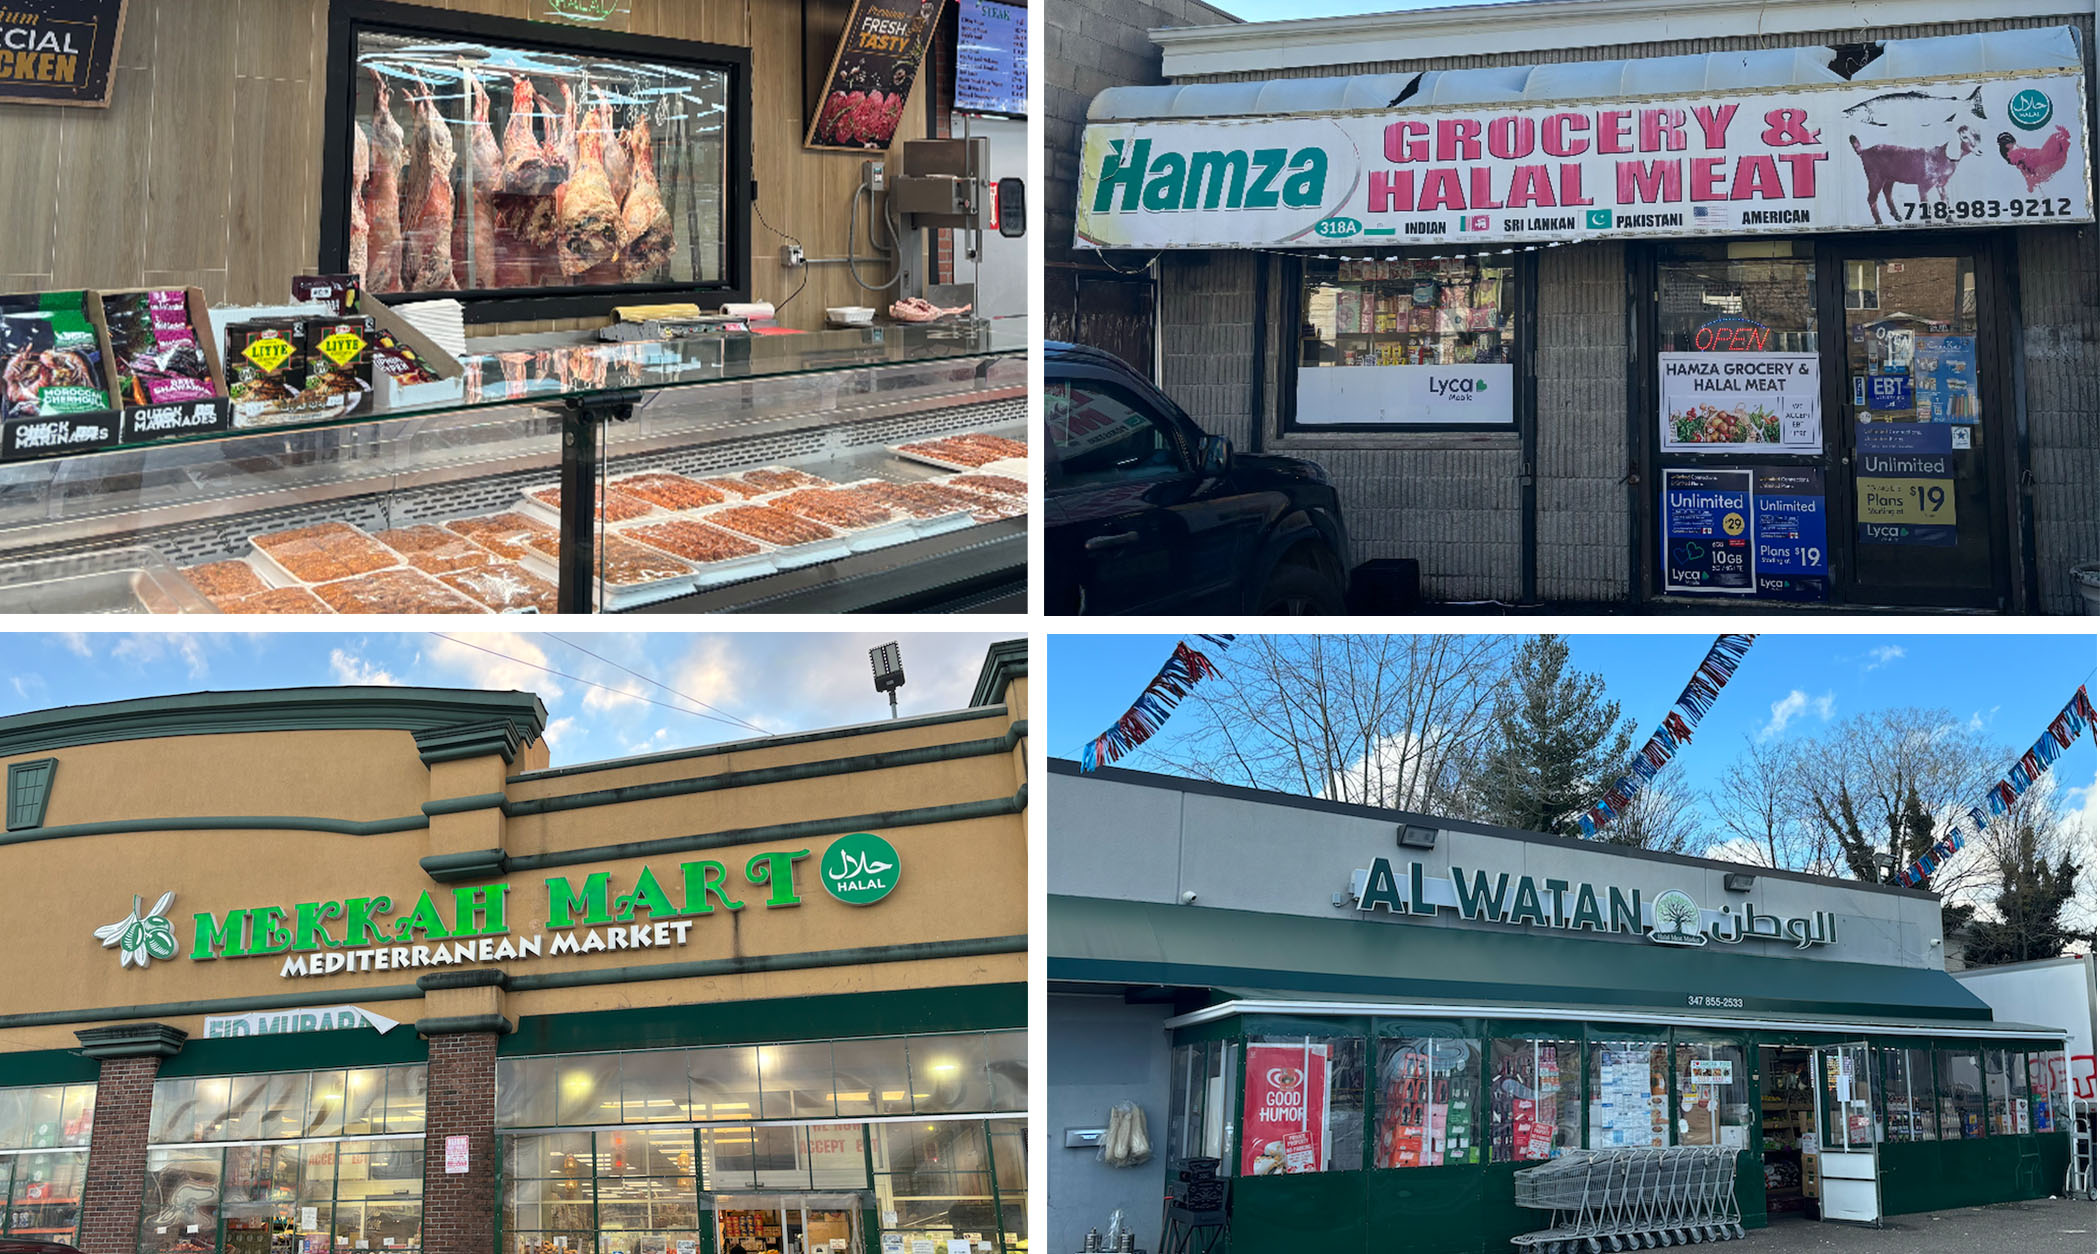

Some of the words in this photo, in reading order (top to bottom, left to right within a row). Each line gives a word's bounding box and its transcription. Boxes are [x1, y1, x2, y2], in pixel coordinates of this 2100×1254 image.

[862, 16, 907, 36] FRESH
[0, 27, 79, 54] CIAL
[859, 32, 911, 53] TASTY
[2013, 95, 2047, 112] حلال
[1384, 103, 1740, 164] GROCERY
[1761, 107, 1822, 147] &
[1092, 138, 1329, 214] Hamza
[1367, 161, 1594, 214] HALAL
[1616, 151, 1829, 206] MEAT
[1903, 199, 2072, 222] 718-983-9212
[1320, 219, 1358, 236] 318A
[1405, 220, 1447, 236] INDIAN
[1504, 218, 1526, 233] SRI
[1528, 216, 1576, 232] LANKAN
[1616, 212, 1683, 229] PAKISTANI
[1742, 209, 1811, 226] AMERICAN
[1695, 328, 1770, 350] OPEN
[1666, 363, 1720, 376] HAMZA
[1724, 362, 1794, 375] GROCERY
[1799, 363, 1810, 375] &
[1430, 376, 1473, 396] Lyca
[1694, 378, 1742, 391] HALAL
[1745, 378, 1787, 391] MEAT
[1874, 377, 1904, 395] EBT
[1865, 456, 1945, 473] Unlimited
[1670, 493, 1744, 509] Unlimited
[1760, 500, 1816, 512] Unlimited
[1867, 493, 1904, 507] Plans
[1909, 486, 1945, 512] $19
[1867, 524, 1899, 538] Lyca
[1760, 545, 1791, 558] Plans
[1794, 547, 1821, 567] $19
[1672, 568, 1701, 581] Lyca
[1760, 578, 1783, 589] Lyca
[828, 849, 893, 881] حلال
[837, 878, 887, 893] HALAL
[1356, 856, 1438, 918] AL
[1448, 865, 1645, 935] WATAN
[189, 883, 510, 961] MEKKAH
[544, 848, 811, 931] MART
[1710, 901, 1840, 950] الوطن
[280, 934, 542, 978] MEDITERRANEAN
[548, 920, 693, 957] MARKET
[1687, 995, 1703, 1006] 347
[1705, 996, 1743, 1008] 855-2533
[209, 1018, 251, 1038] EID
[257, 1011, 373, 1035] MUBARA
[1266, 1091, 1301, 1107] GOOD
[1259, 1107, 1304, 1122] HUMOR
[856, 1138, 878, 1153] ET
